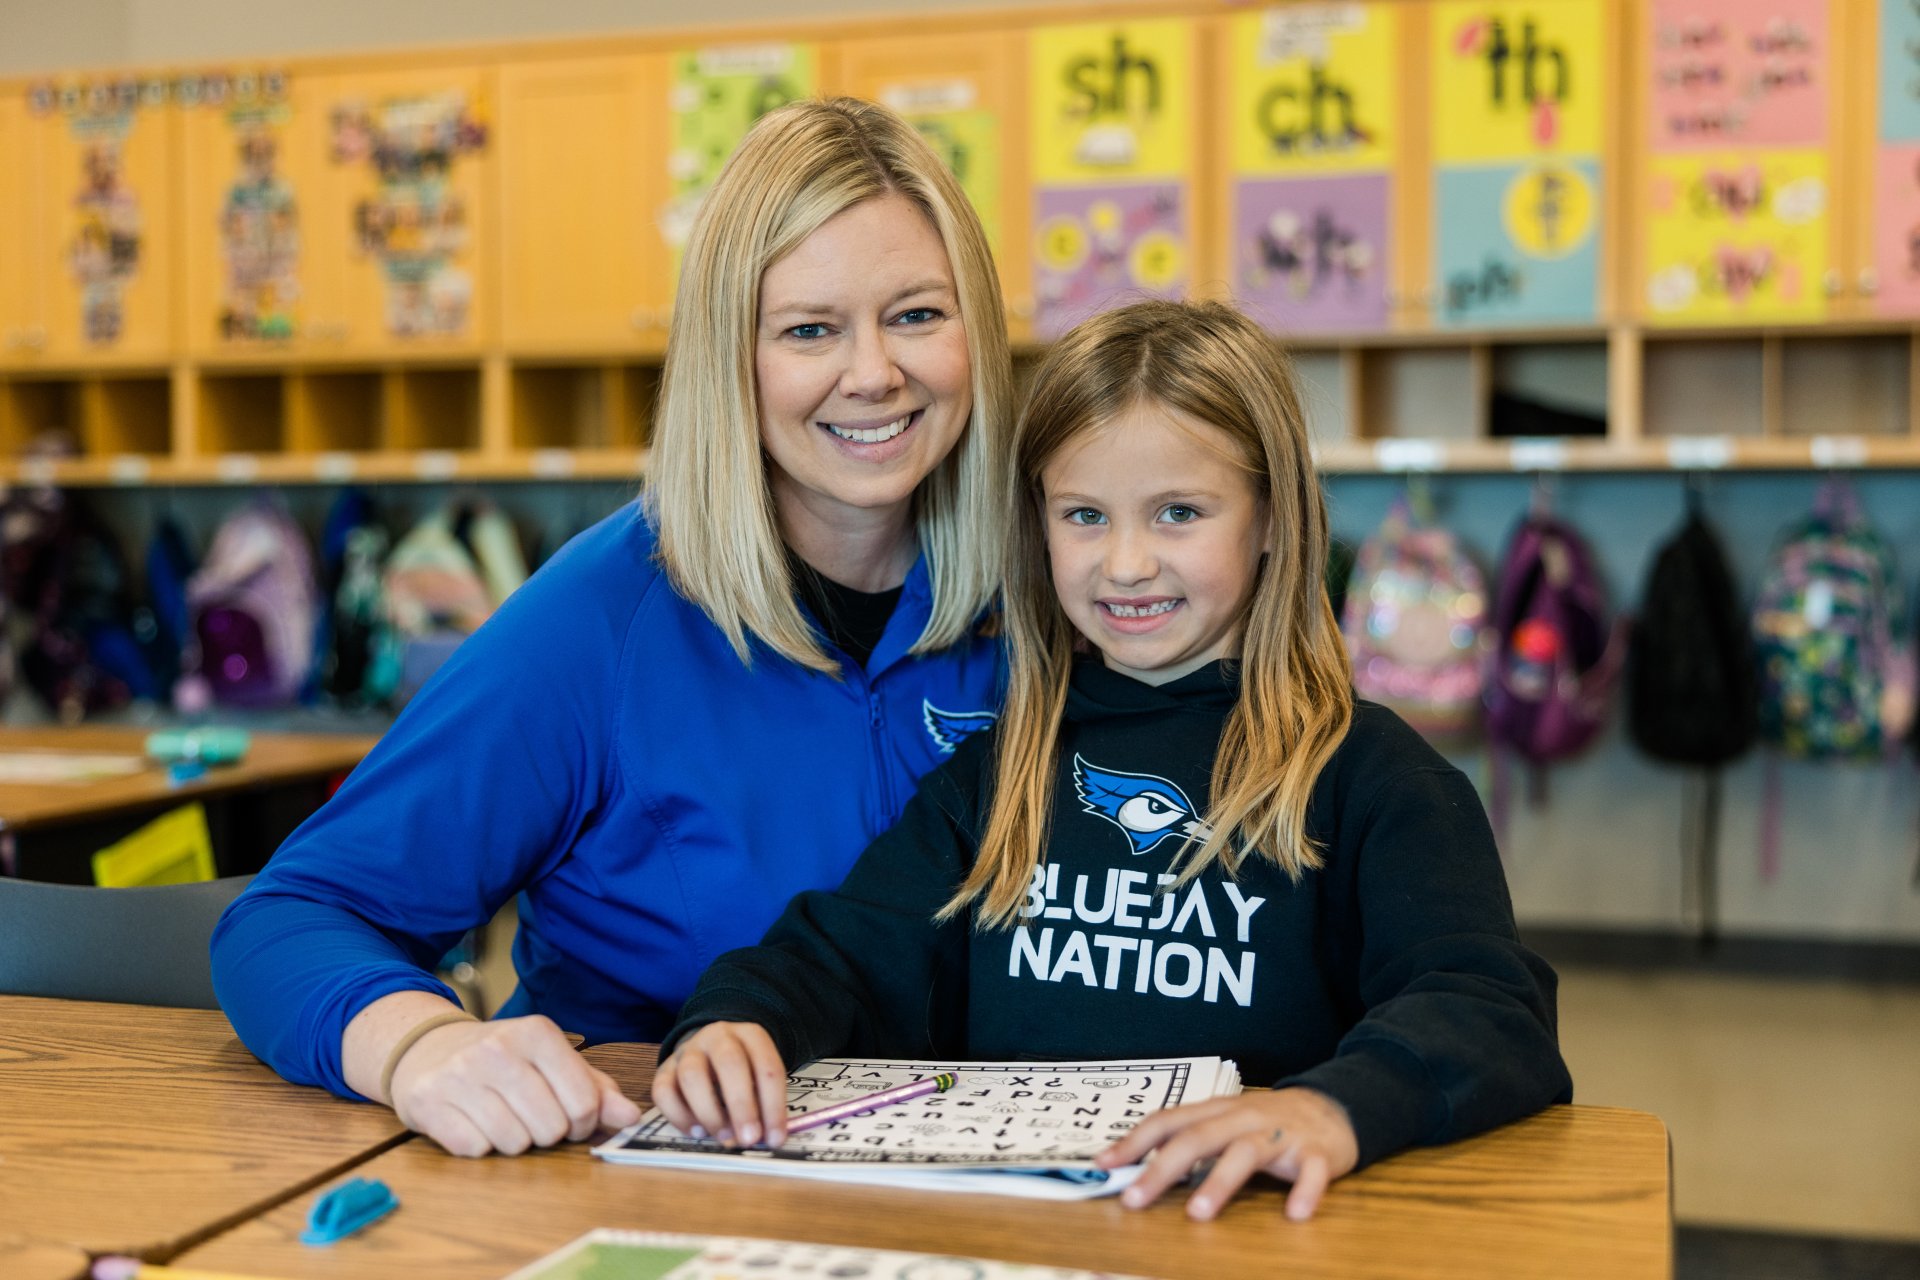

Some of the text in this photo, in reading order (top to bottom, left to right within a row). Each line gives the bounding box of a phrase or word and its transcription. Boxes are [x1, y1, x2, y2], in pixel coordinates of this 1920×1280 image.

[1061, 28, 1162, 117] sh
[1488, 14, 1570, 107] th
[1256, 60, 1355, 146] ch
[1016, 863, 1266, 943] BLUEJAY
[1008, 925, 1256, 1007] NATION
[923, 1097, 948, 1107] 2
[1009, 1090, 1034, 1099] d
